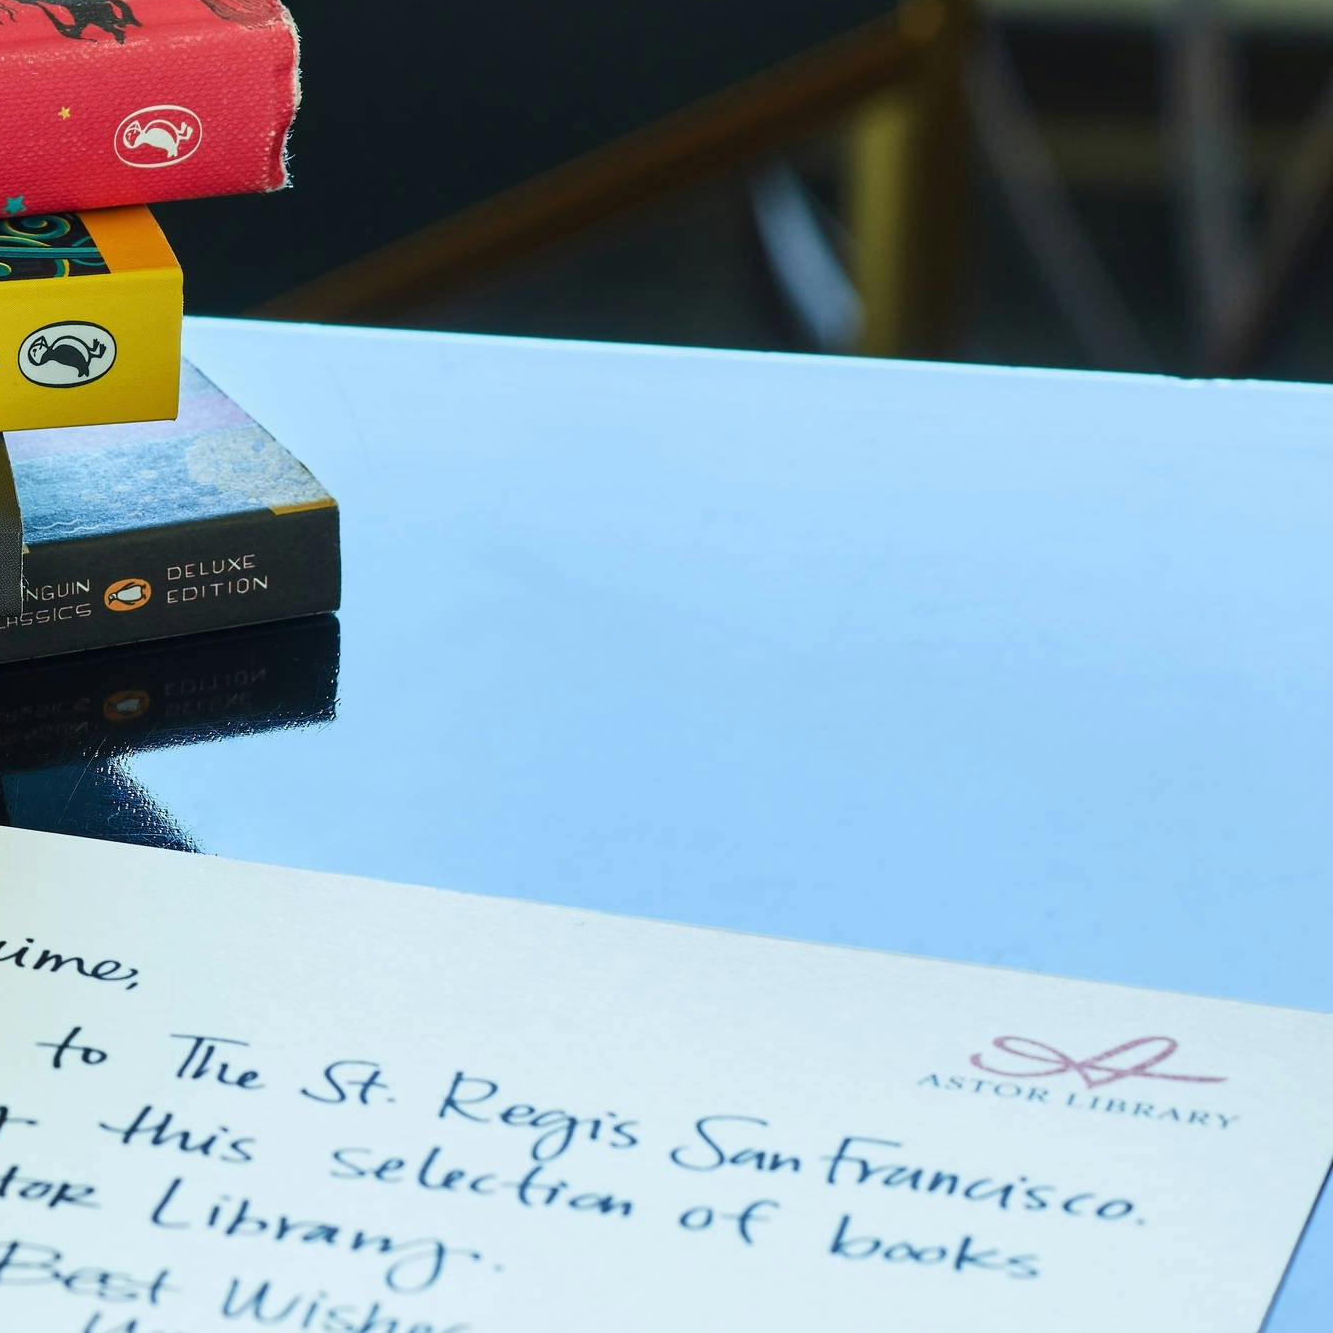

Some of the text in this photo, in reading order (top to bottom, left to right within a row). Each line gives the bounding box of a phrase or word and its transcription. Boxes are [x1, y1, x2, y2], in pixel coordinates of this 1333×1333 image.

[24, 578, 91, 603] NGUIN
[166, 553, 257, 581] DELUXE
[166, 575, 269, 604] EDITION
[36, 1026, 109, 1069] to
[170, 1032, 266, 1093] The
[300, 1059, 398, 1106] St.
[436, 1071, 641, 1162] Regis
[669, 1115, 804, 1175] San
[818, 1136, 1147, 1227] Francisco.
[916, 1070, 1243, 1131] ASTOR LIBRARY
[98, 1104, 255, 1165] this
[330, 1146, 633, 1220] selection
[677, 1199, 780, 1246] of
[827, 1214, 1041, 1281] books
[220, 1277, 475, 1333] Wish
